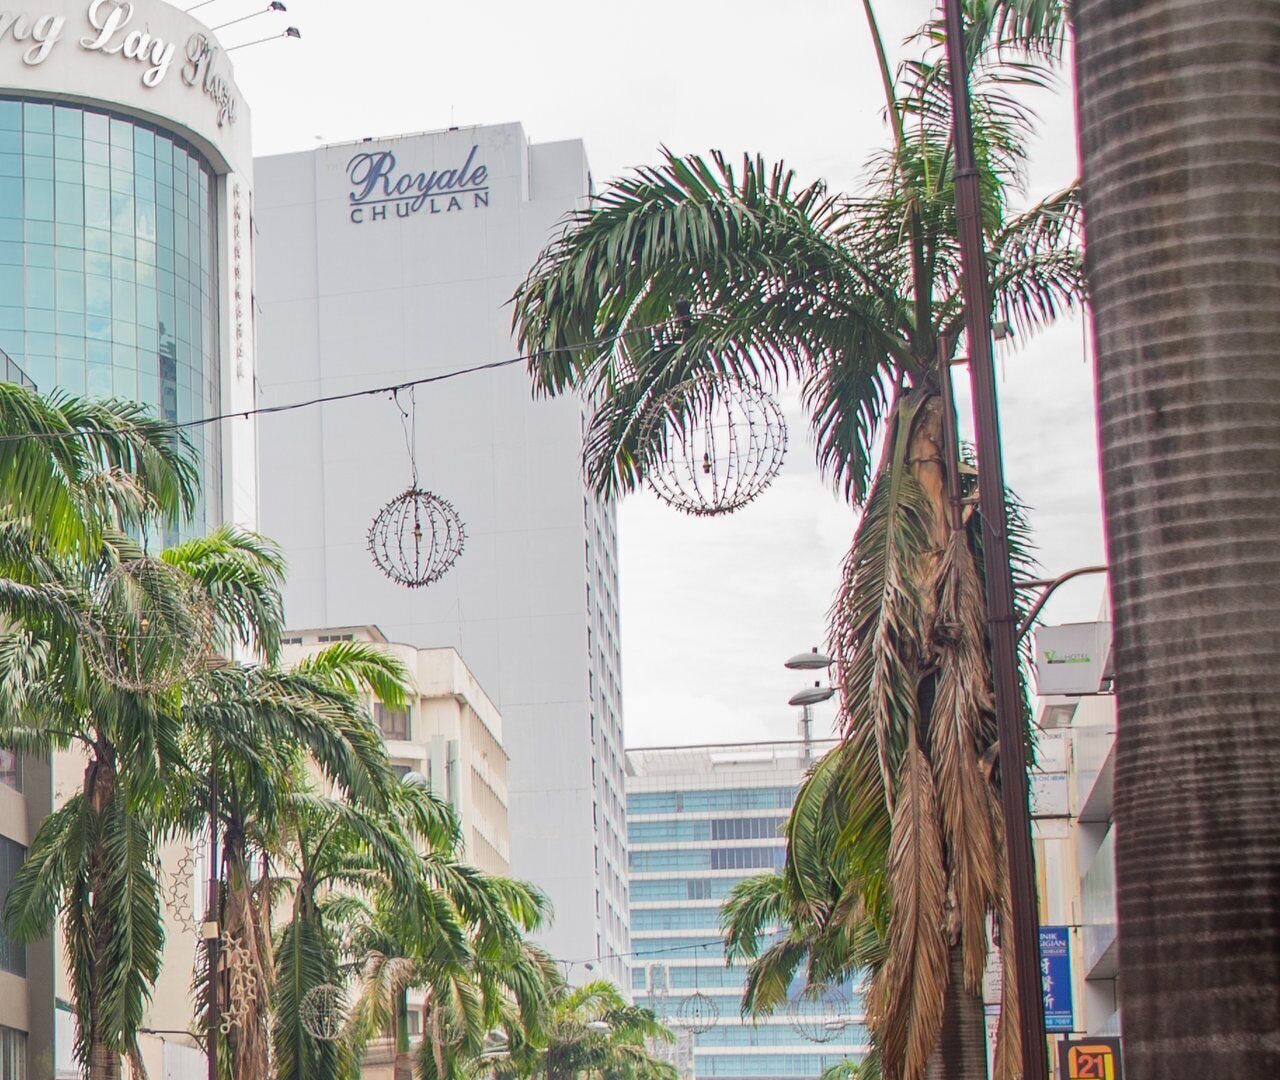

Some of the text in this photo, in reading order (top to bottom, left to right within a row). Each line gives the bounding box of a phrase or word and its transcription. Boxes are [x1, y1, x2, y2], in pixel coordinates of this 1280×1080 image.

[80, 0, 175, 88] Lay
[346, 145, 488, 212] Royale
[350, 192, 489, 224] CHULAN
[1078, 1054, 1104, 1079] 21
